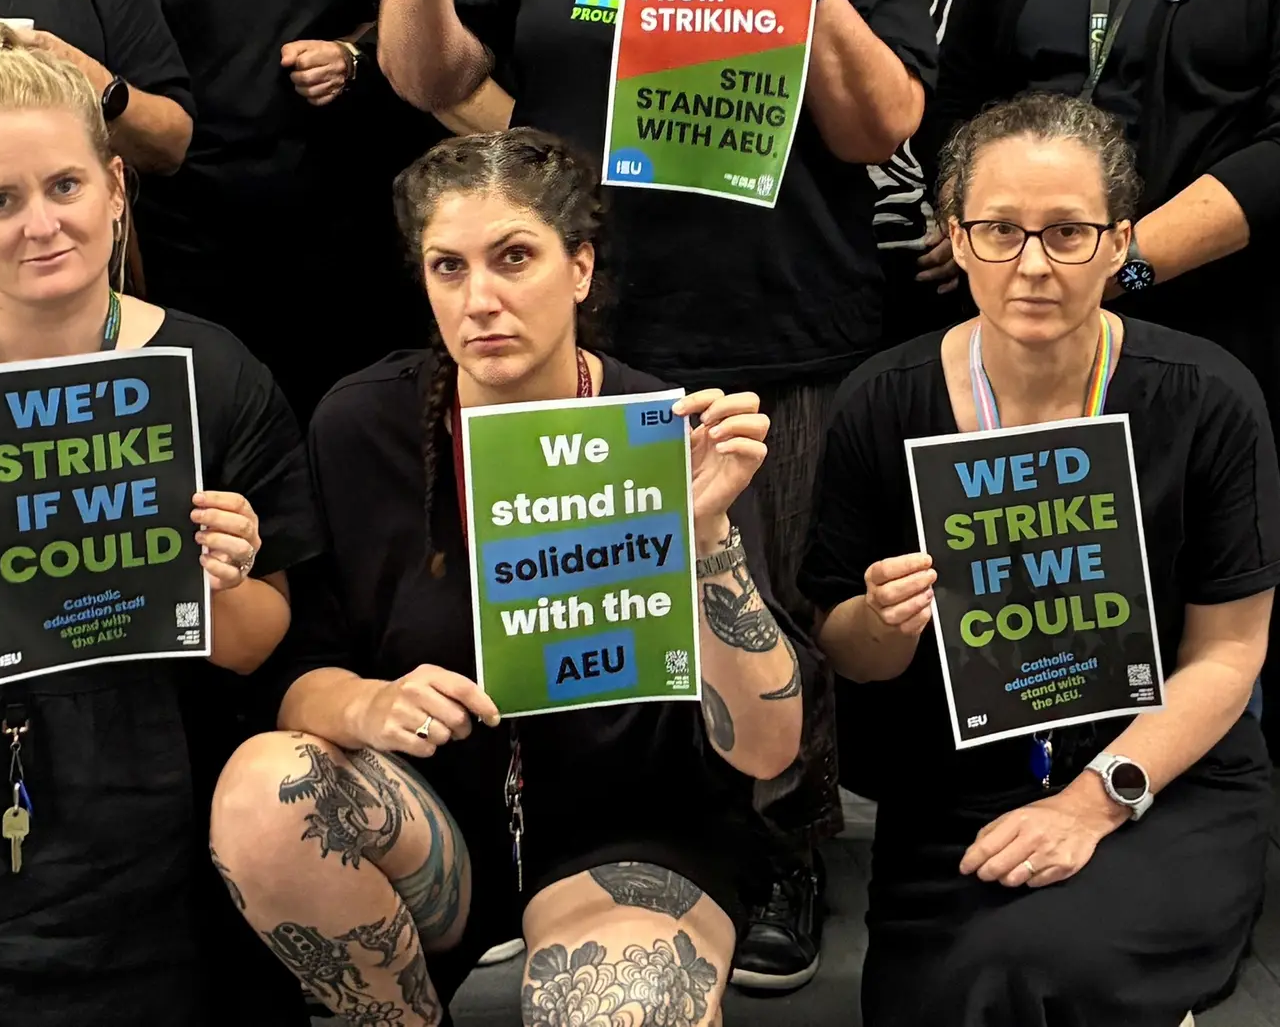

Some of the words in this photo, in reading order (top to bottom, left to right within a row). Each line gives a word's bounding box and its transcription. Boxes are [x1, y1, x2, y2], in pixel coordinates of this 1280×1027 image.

[570, 7, 619, 25] PROU
[640, 7, 784, 34] STRIKING.
[720, 68, 790, 99] STILL
[636, 87, 786, 127] STANDING
[637, 116, 711, 147] WITH
[718, 129, 778, 159] AEU.
[5, 377, 150, 428] WE'D
[641, 409, 673, 426] IEU
[539, 433, 609, 467] We
[954, 447, 1091, 498] WE'D
[16, 491, 61, 532] IF
[73, 477, 159, 523] WE
[491, 484, 615, 526] stand
[624, 479, 662, 514] in
[944, 493, 1118, 550] STRIKE
[0, 527, 182, 583] COULD
[494, 533, 673, 584] solidarity
[970, 556, 1011, 595] IF
[1022, 543, 1105, 587] WE
[43, 605, 112, 630] education
[115, 595, 146, 612] staff
[63, 589, 121, 611] Catholic
[500, 595, 595, 636] with
[602, 589, 672, 623] the
[60, 619, 99, 639] stand
[101, 614, 132, 628] with
[72, 634, 95, 650] the
[97, 627, 128, 643] AEU.
[960, 592, 1130, 648] COULD
[556, 645, 625, 685] AEU
[1004, 666, 1067, 692] education
[1070, 657, 1098, 674] staff
[1021, 651, 1074, 673] Catholic
[1020, 681, 1056, 701] stand
[1057, 674, 1086, 690] with
[1032, 696, 1053, 711] the
[1054, 689, 1082, 705] AEU.
